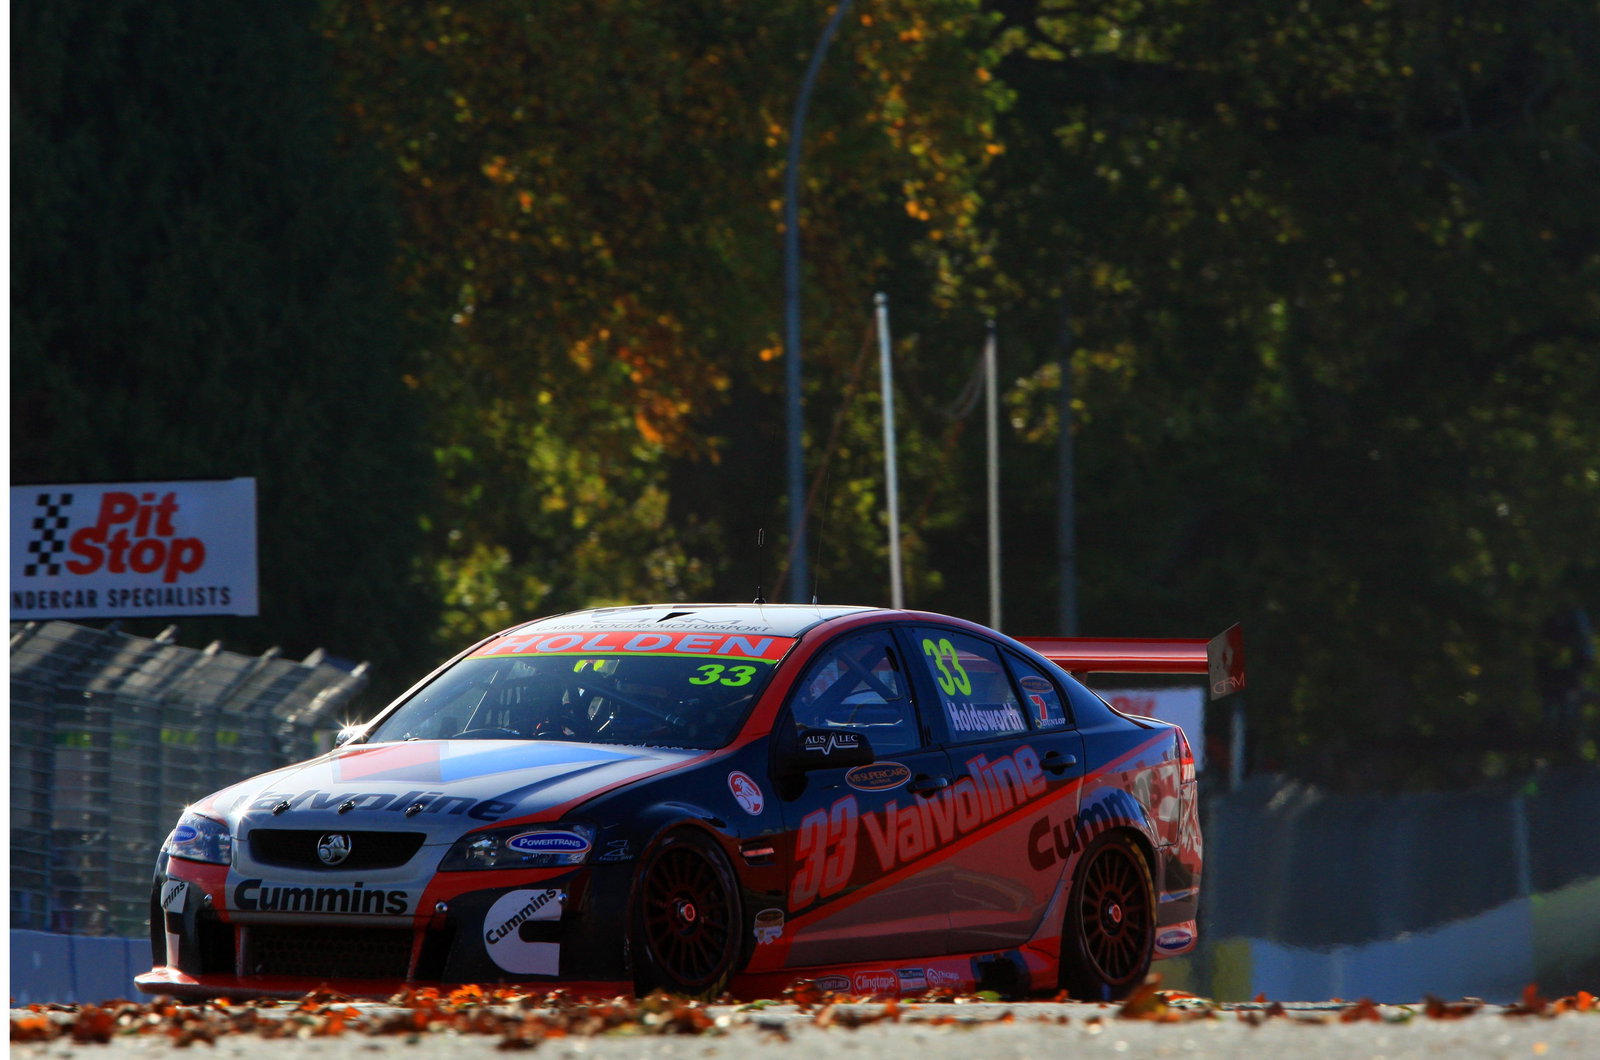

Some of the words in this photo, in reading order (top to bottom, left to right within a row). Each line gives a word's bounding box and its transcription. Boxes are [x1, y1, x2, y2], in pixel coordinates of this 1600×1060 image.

[97, 492, 179, 543] Pit
[65, 527, 206, 583] Stop
[107, 586, 231, 608] SPECIALISTS
[485, 633, 775, 657] HOLDEN
[655, 623, 775, 633] MOTORSPORT
[688, 664, 757, 687] 33
[922, 638, 972, 696] 33
[946, 701, 1026, 733] Holdsworth
[862, 745, 1048, 873] Valvoline
[788, 794, 859, 914] 33
[234, 879, 408, 914] Cummins
[485, 888, 557, 945] Cummins
